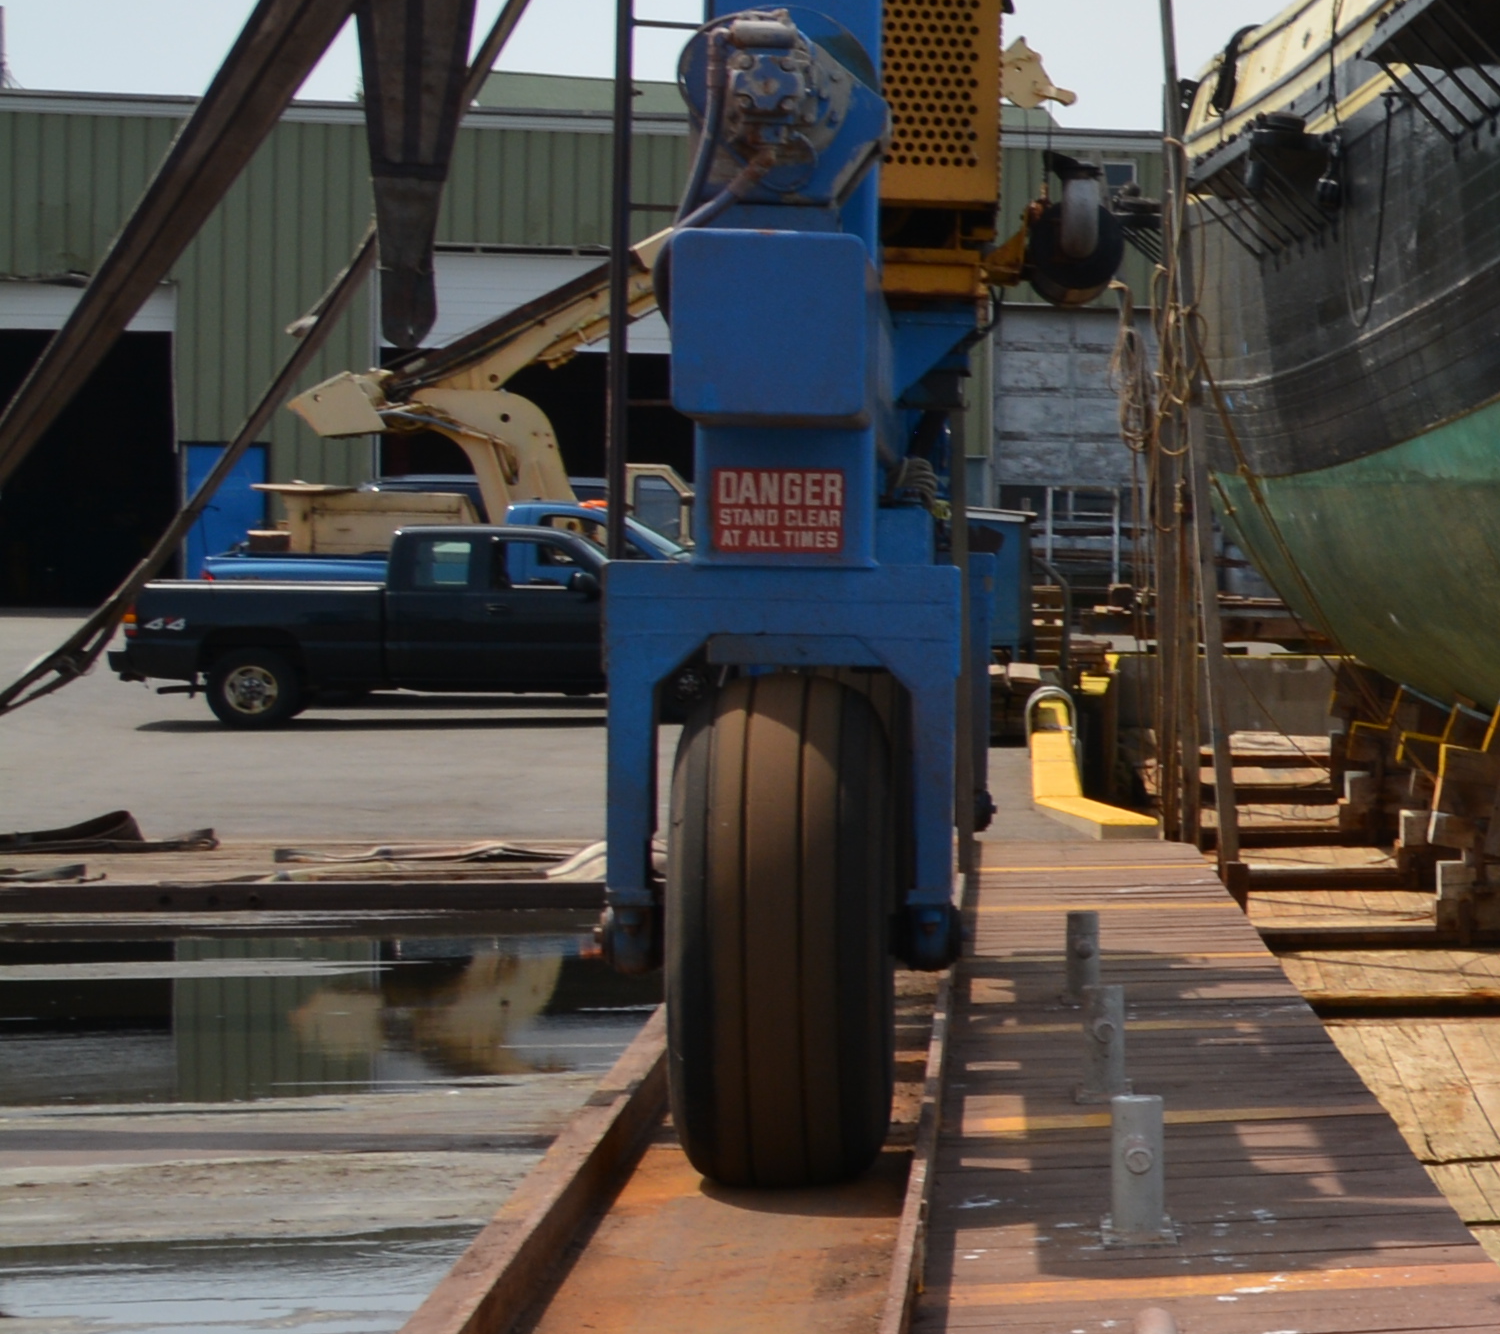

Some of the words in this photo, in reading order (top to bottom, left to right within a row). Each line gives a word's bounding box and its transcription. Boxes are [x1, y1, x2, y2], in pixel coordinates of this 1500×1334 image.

[719, 471, 843, 506] DANGER
[720, 509, 779, 526] STAND
[784, 509, 841, 527] CLEAR
[721, 530, 742, 547] AT
[747, 530, 780, 547] ALL
[783, 531, 838, 548] TIMES
